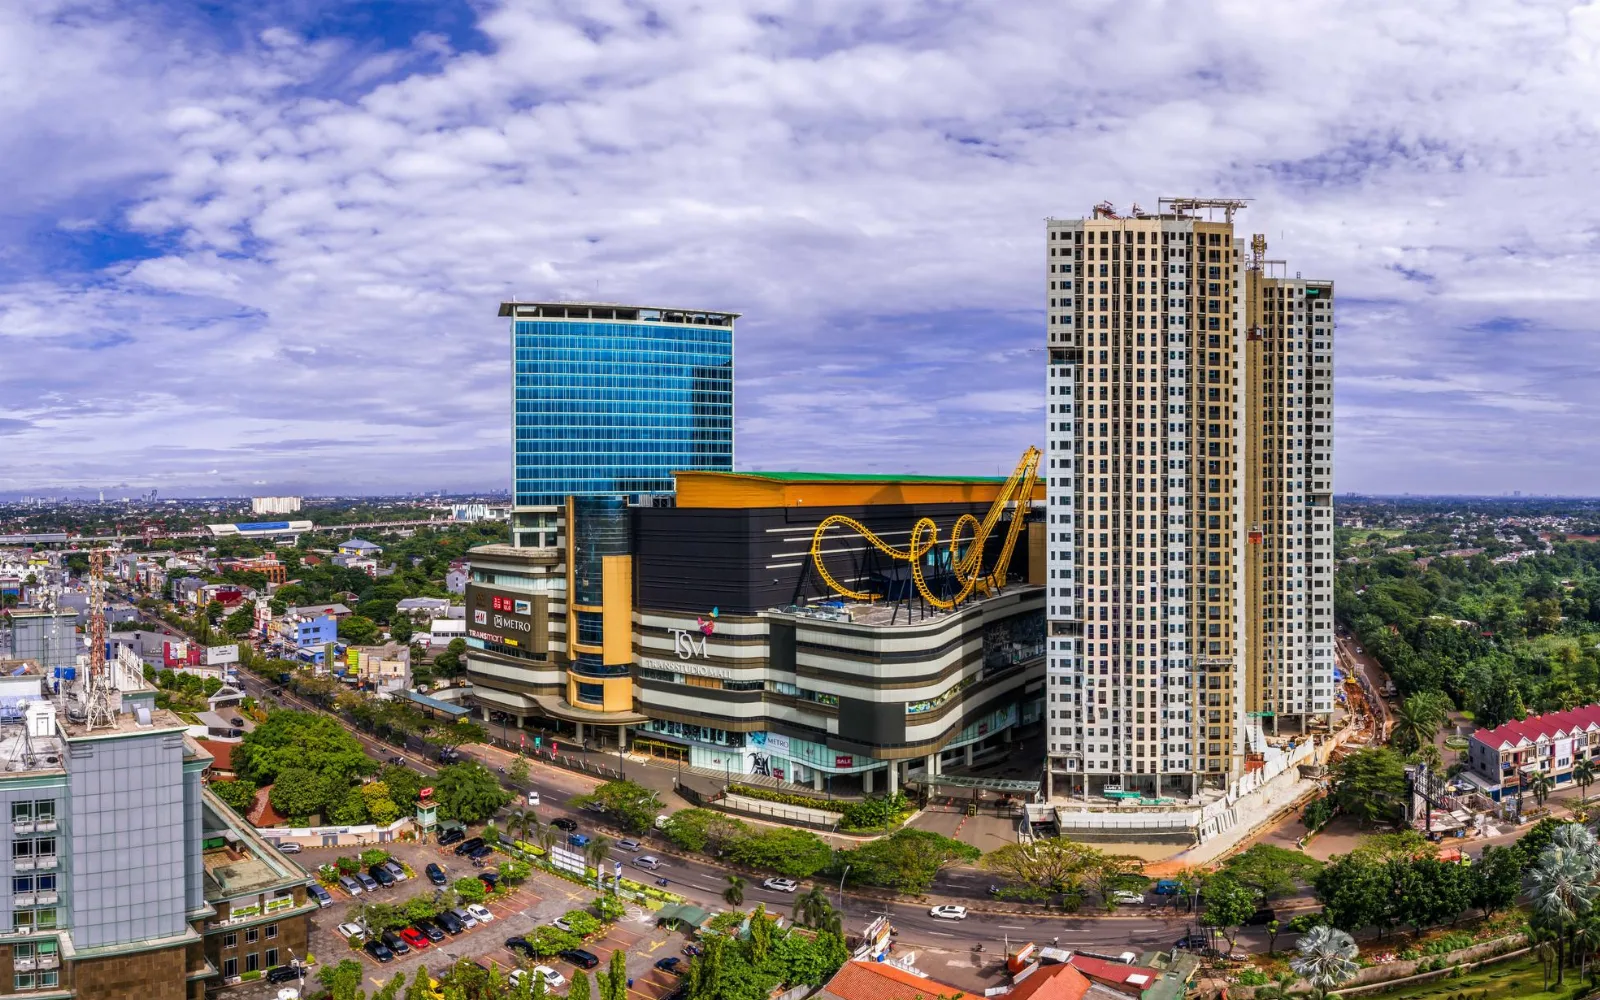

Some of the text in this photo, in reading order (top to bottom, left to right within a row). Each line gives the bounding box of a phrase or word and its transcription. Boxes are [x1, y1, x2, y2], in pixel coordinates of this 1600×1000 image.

[504, 618, 530, 632] METRO
[668, 628, 710, 660] TSM
[647, 660, 732, 678] TRANS STUDIO MALL
[768, 738, 788, 748] METRO
